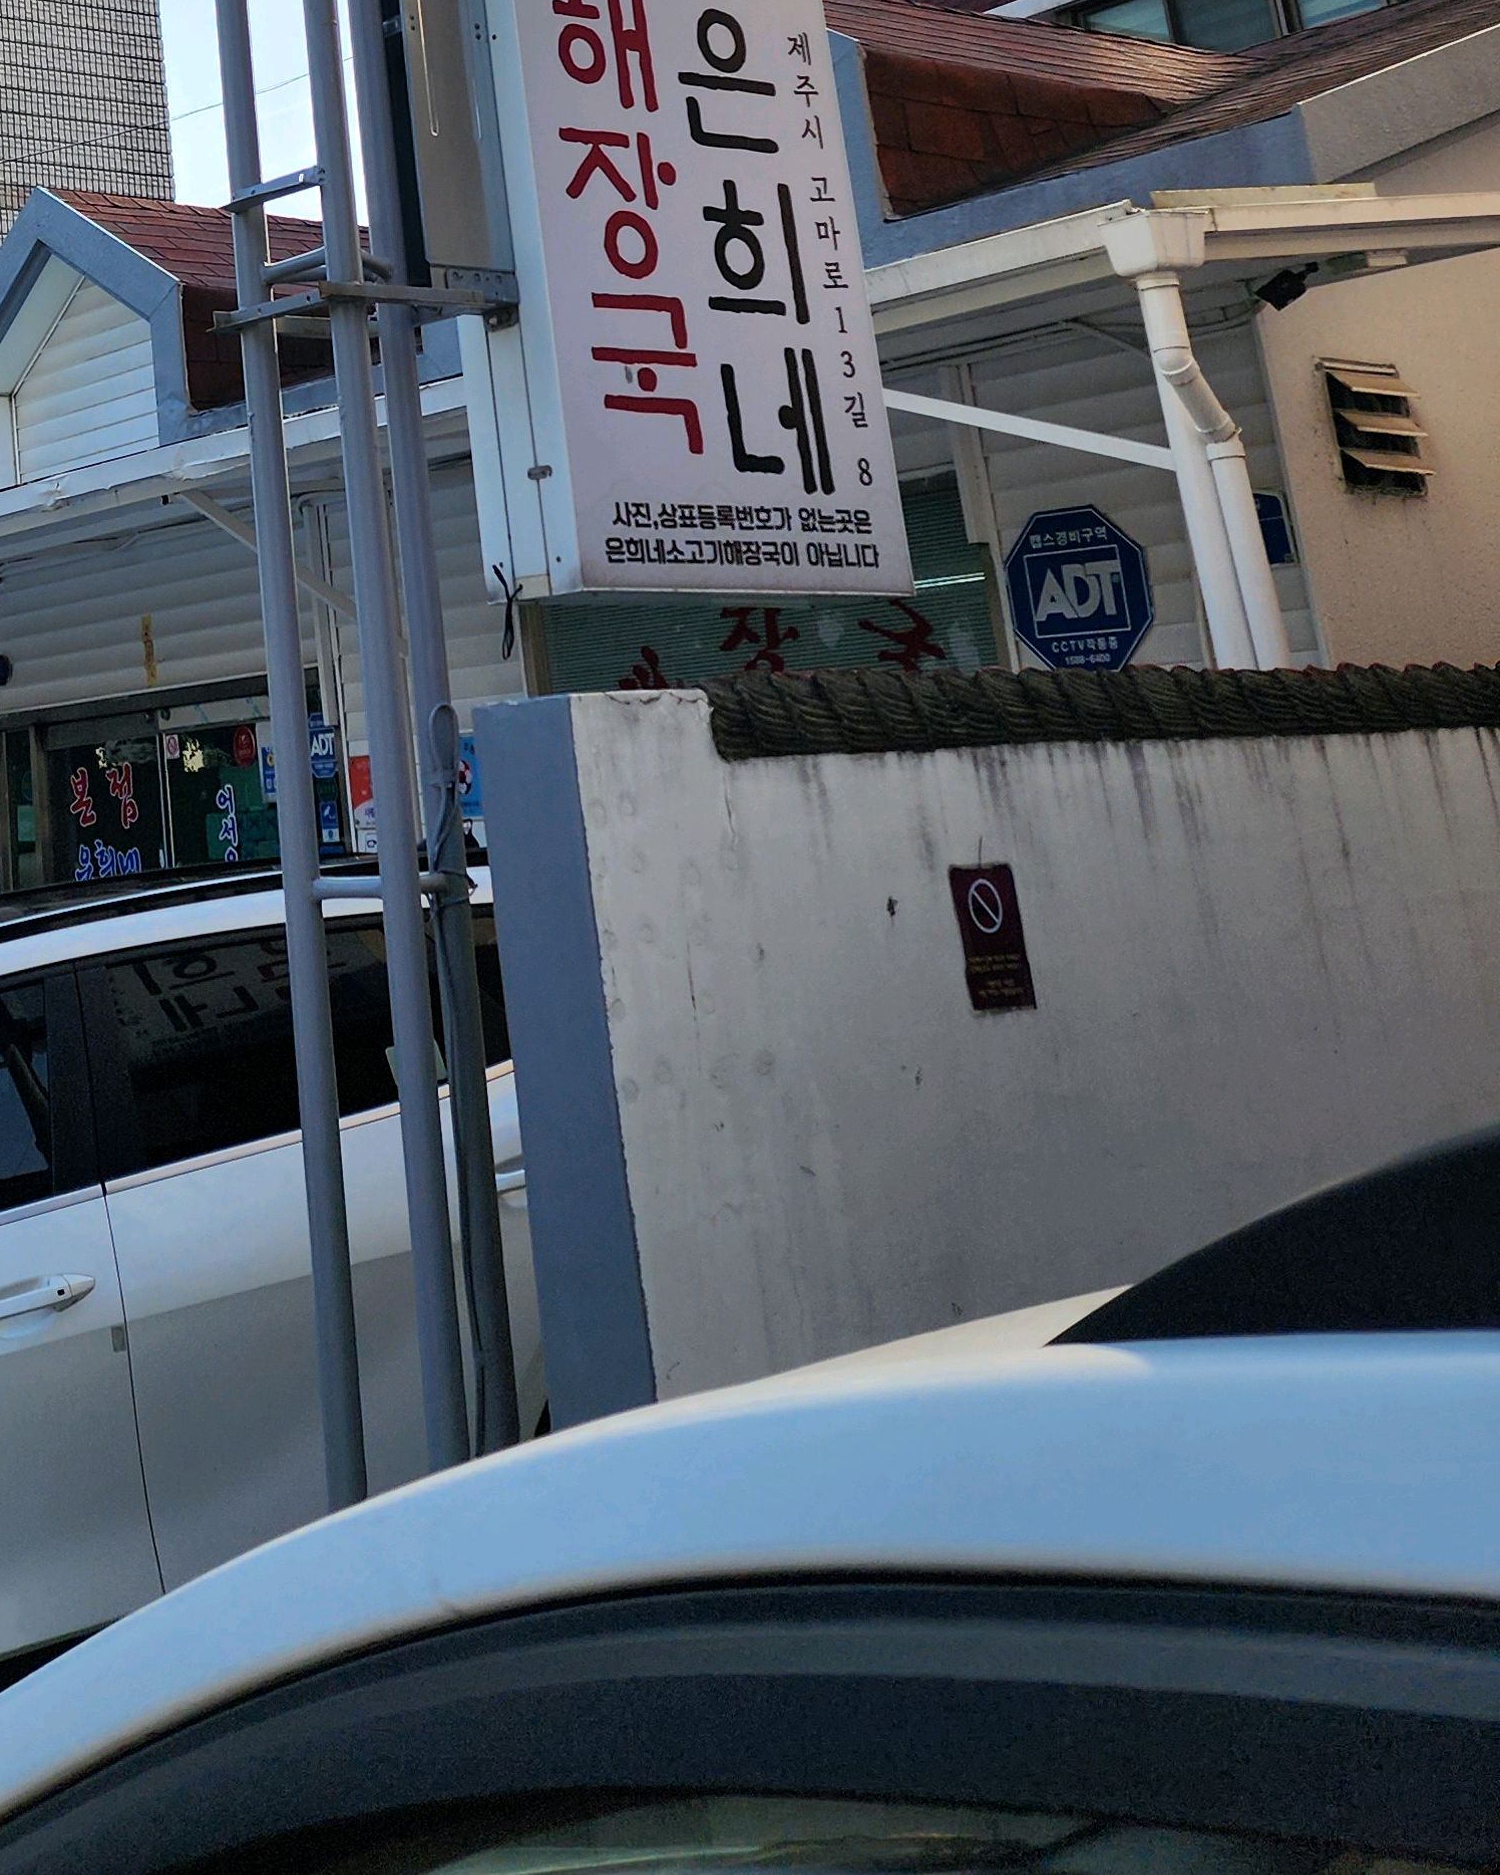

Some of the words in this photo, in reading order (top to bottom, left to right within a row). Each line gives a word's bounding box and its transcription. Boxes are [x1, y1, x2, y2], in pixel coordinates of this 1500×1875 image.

[677, 8, 836, 495] 은희네
[787, 32, 825, 150] 제주시
[857, 458, 874, 487] 8
[612, 501, 793, 532] 사진,상표등록번호가
[798, 506, 873, 535] 없는곳은
[604, 536, 801, 567] 은희네소고기해장국이
[805, 541, 881, 570] 아닙니다
[1035, 558, 1123, 622] ADT
[311, 732, 335, 758] ADT
[69, 761, 140, 829] 본점
